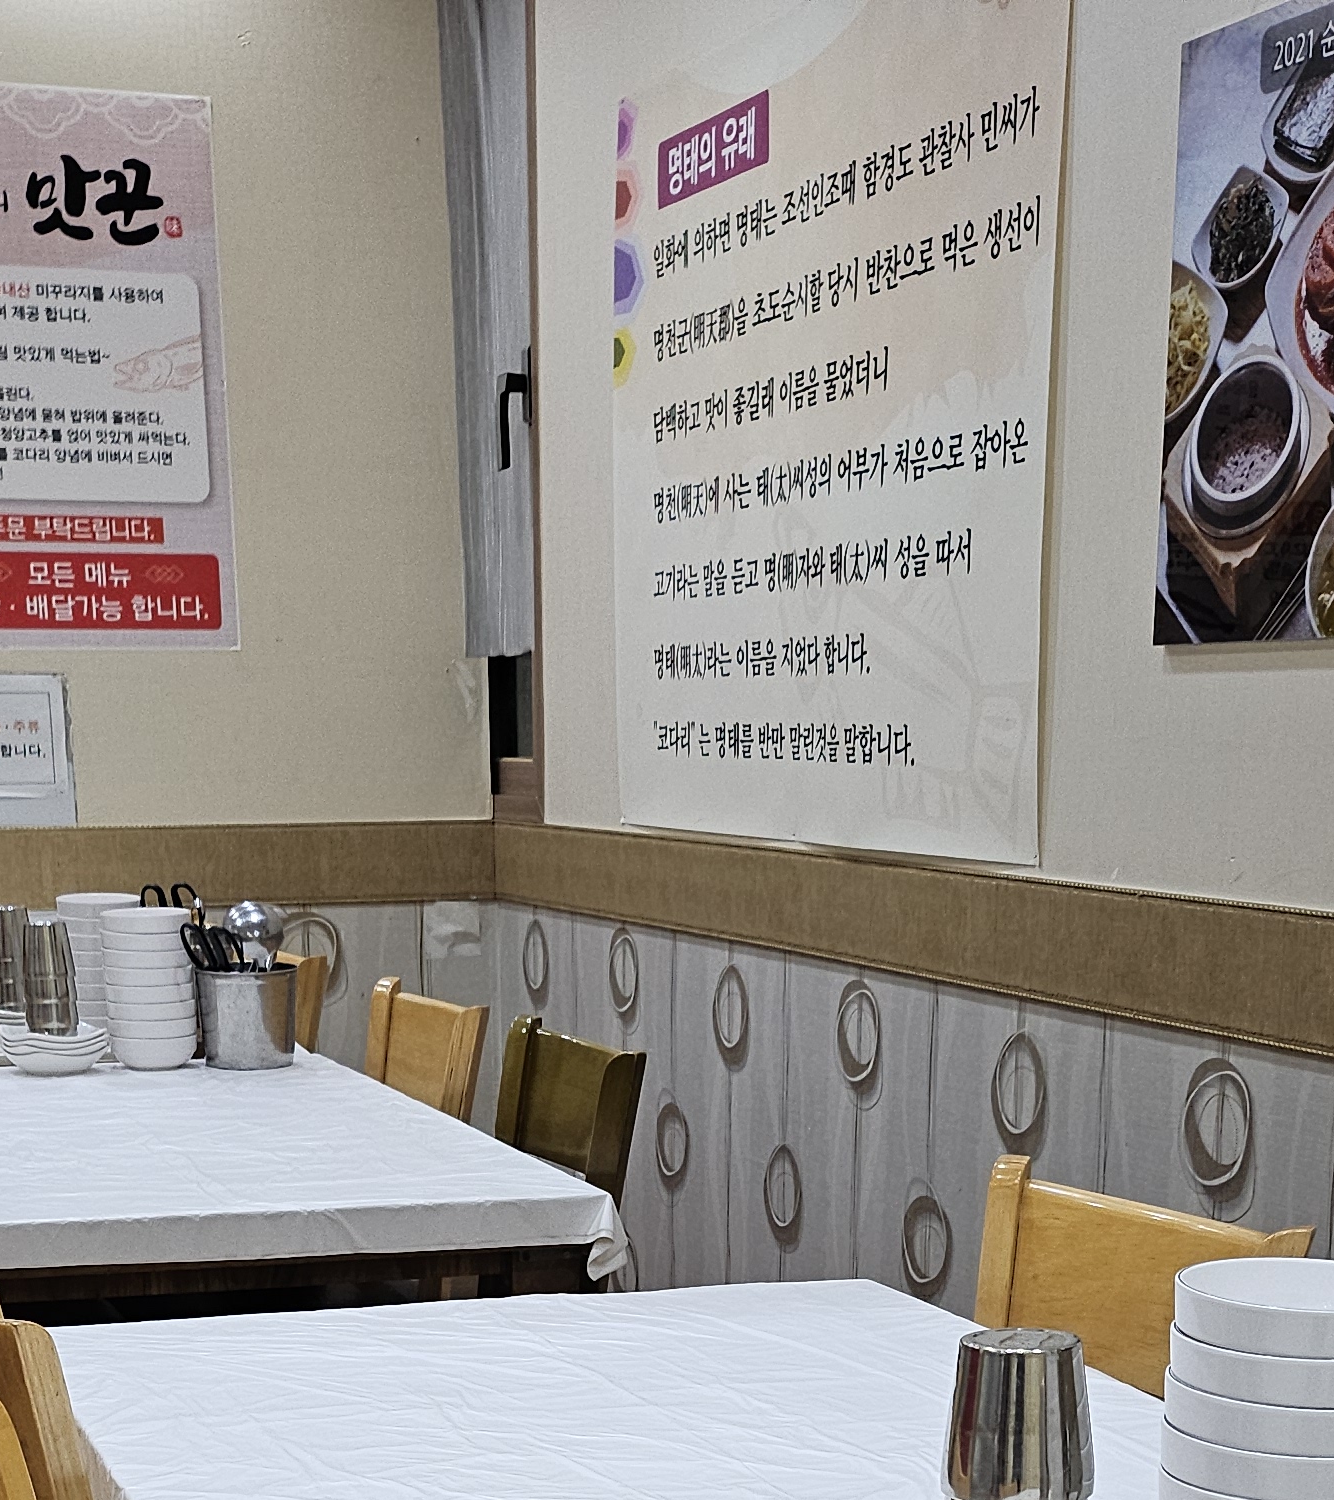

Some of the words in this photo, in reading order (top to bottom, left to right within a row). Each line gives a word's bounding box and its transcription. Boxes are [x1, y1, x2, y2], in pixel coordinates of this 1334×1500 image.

[1273, 28, 1315, 71] 2021
[668, 125, 717, 195] 명태의
[721, 105, 756, 171] 유래
[25, 153, 165, 246] 맛꾼
[653, 229, 688, 279] 일화에
[693, 212, 731, 263] 의하면
[736, 198, 777, 247] 명태는
[781, 160, 856, 225] 조선인조때
[863, 143, 914, 200] 함경도
[918, 112, 975, 176] 관찰사
[980, 86, 1040, 152] 민씨가
[752, 269, 824, 327] 초도순시할
[827, 257, 859, 307] 당시
[866, 237, 935, 295] 반찬으로
[942, 220, 978, 272] 먹은
[983, 195, 1041, 259] 생선이
[11, 304, 40, 322] 제공
[35, 283, 104, 303] 미꾸라지를
[109, 286, 164, 304] 사용하여
[13, 345, 56, 362] 맛있게
[653, 400, 701, 444] 담백하고
[705, 389, 728, 434] 맛이
[732, 377, 774, 426] 좋길래
[779, 365, 819, 414] 이름을
[824, 345, 889, 402] 물었더니
[12, 446, 50, 462] 코다리
[136, 450, 173, 466] 드시면
[95, 429, 134, 445] 맛있게
[723, 473, 752, 513] 사는
[756, 453, 832, 507] 태(太)씨성의
[837, 443, 888, 493] 어부가
[893, 433, 965, 485] 처음으로
[970, 417, 1029, 472] 잡아온
[33, 515, 155, 541] 부탁드립니다.
[28, 561, 75, 588] 모든
[84, 561, 132, 588] 메뉴
[653, 563, 699, 601] 고기라는
[703, 558, 727, 597] 말을
[731, 558, 759, 595] 듣고
[830, 537, 888, 586] 태(太)씨
[894, 533, 930, 579] 성을
[936, 527, 972, 576] 따서
[26, 593, 123, 621] 배달가능
[132, 593, 210, 621] 합니다.
[736, 638, 777, 679] 이름을
[781, 635, 820, 677] 지었다
[823, 632, 871, 676] 합니다.
[698, 723, 711, 757] 는
[714, 721, 754, 759] 명태를
[758, 721, 785, 760] 반만
[789, 722, 840, 763] 말린것을
[844, 723, 916, 767] 말합니다.
